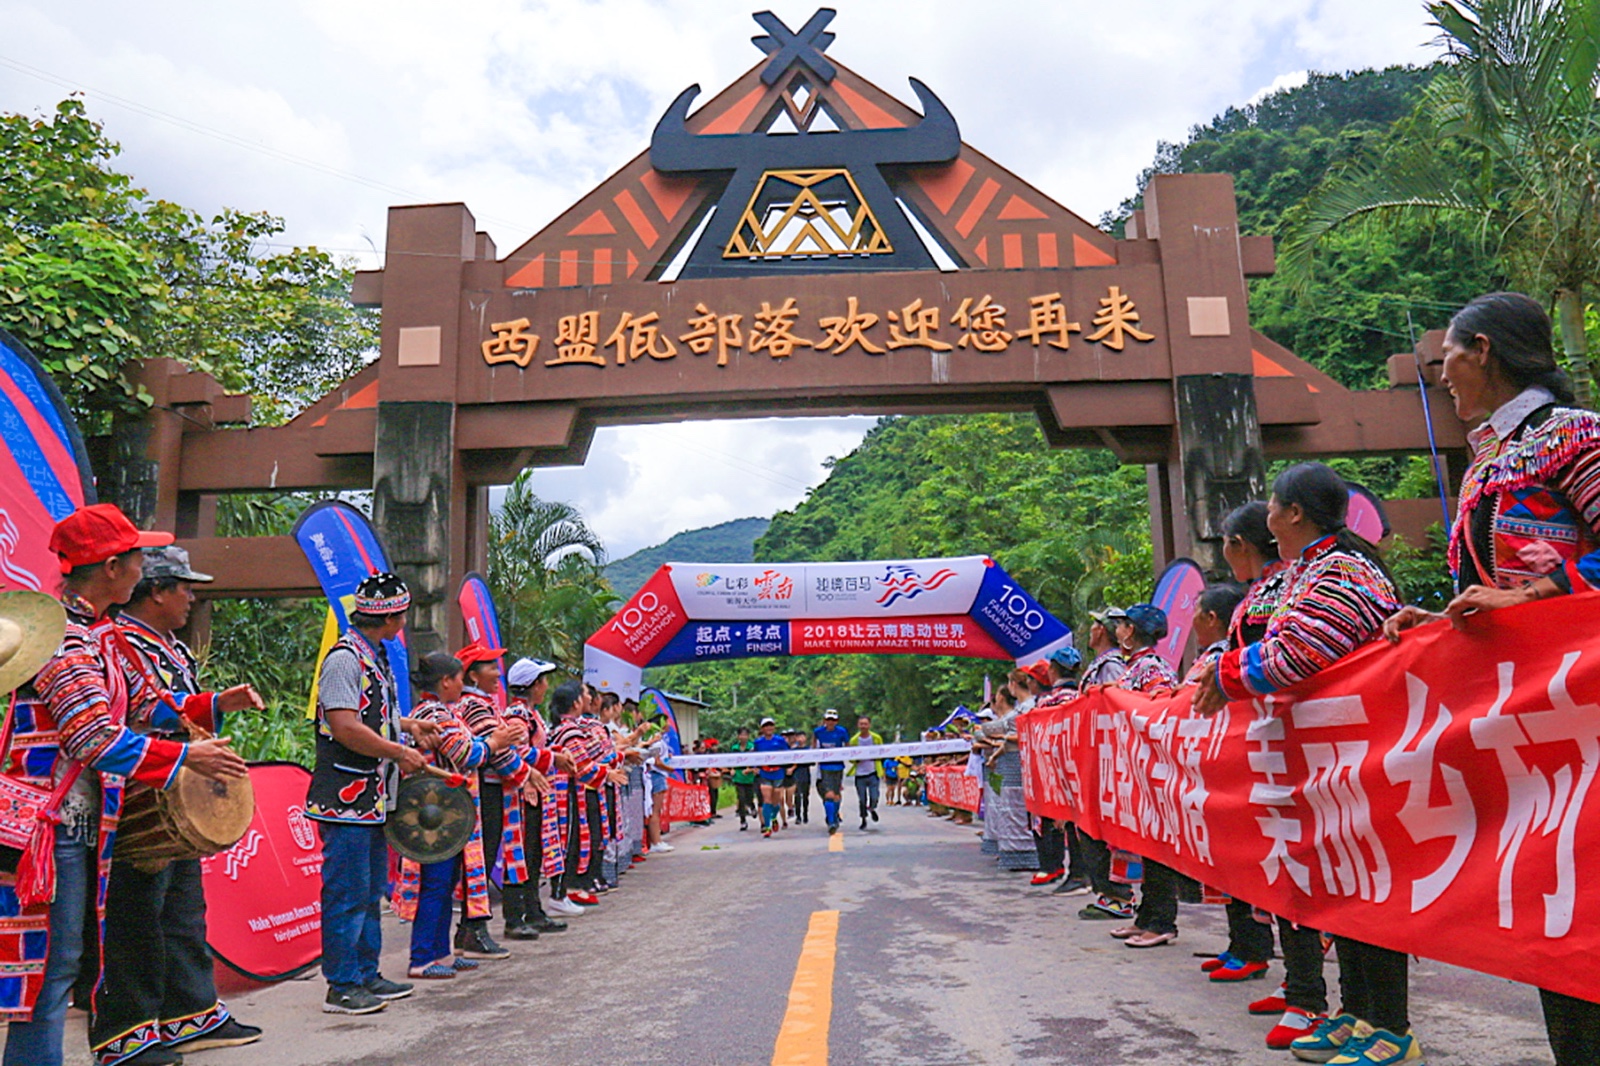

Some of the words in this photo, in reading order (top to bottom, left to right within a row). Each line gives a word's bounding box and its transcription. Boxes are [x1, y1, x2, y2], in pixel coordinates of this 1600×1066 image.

[481, 286, 1154, 368] 西盟佤部落欢迎您再来
[611, 591, 658, 635] 100
[624, 604, 669, 647] FAIRYLAND
[981, 606, 1026, 647] MARATHON
[988, 599, 1032, 640] FAIRYLAND
[999, 584, 1044, 630] 100
[631, 611, 676, 654] MARATHON
[695, 644, 731, 656] START
[746, 642, 782, 653] FINISH
[803, 640, 831, 648] MAKE
[834, 640, 875, 648] YUNNAN
[876, 639, 909, 648] AMAZE
[911, 639, 930, 648] THE
[932, 639, 967, 648] WORLD
[248, 916, 272, 932] Make
[268, 911, 295, 927] Yunnan
[293, 905, 315, 918] Amaze
[274, 926, 301, 942] Fairyland
